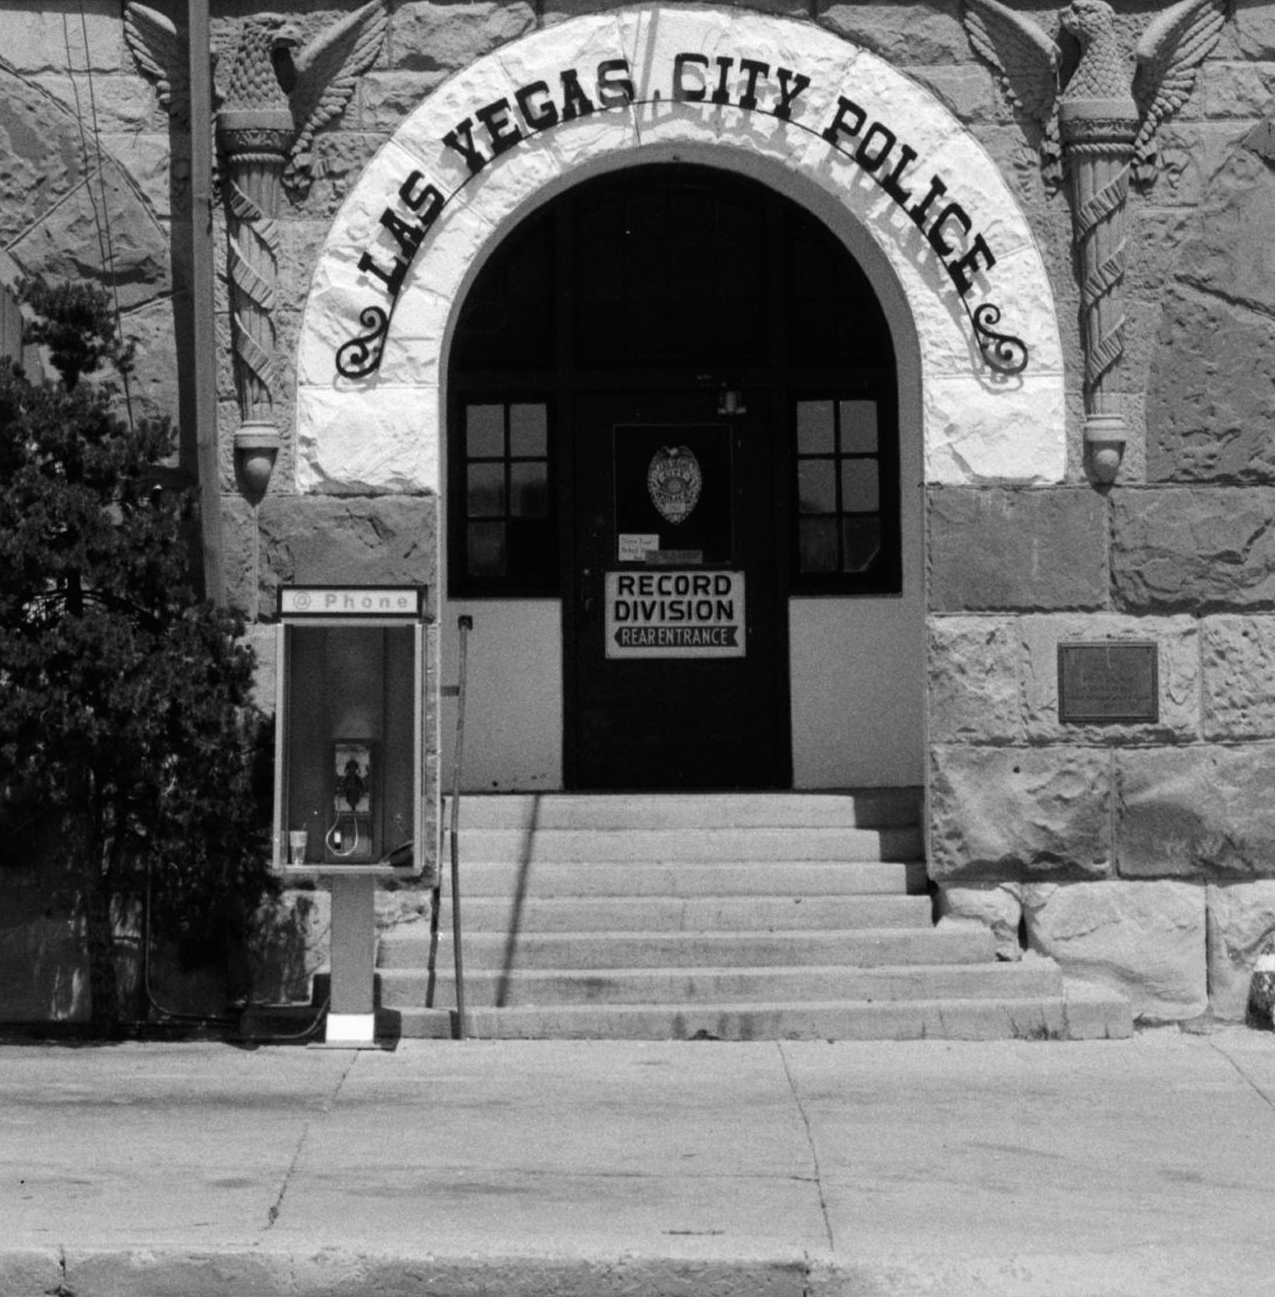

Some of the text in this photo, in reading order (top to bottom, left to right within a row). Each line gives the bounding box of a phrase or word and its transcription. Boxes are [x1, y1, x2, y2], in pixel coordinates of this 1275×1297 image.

[357, 52, 998, 296] LAS VEGAS CITY POLICE
[617, 575, 733, 597] RECORD
[324, 593, 409, 609] Phone
[615, 600, 735, 622] DIVISION
